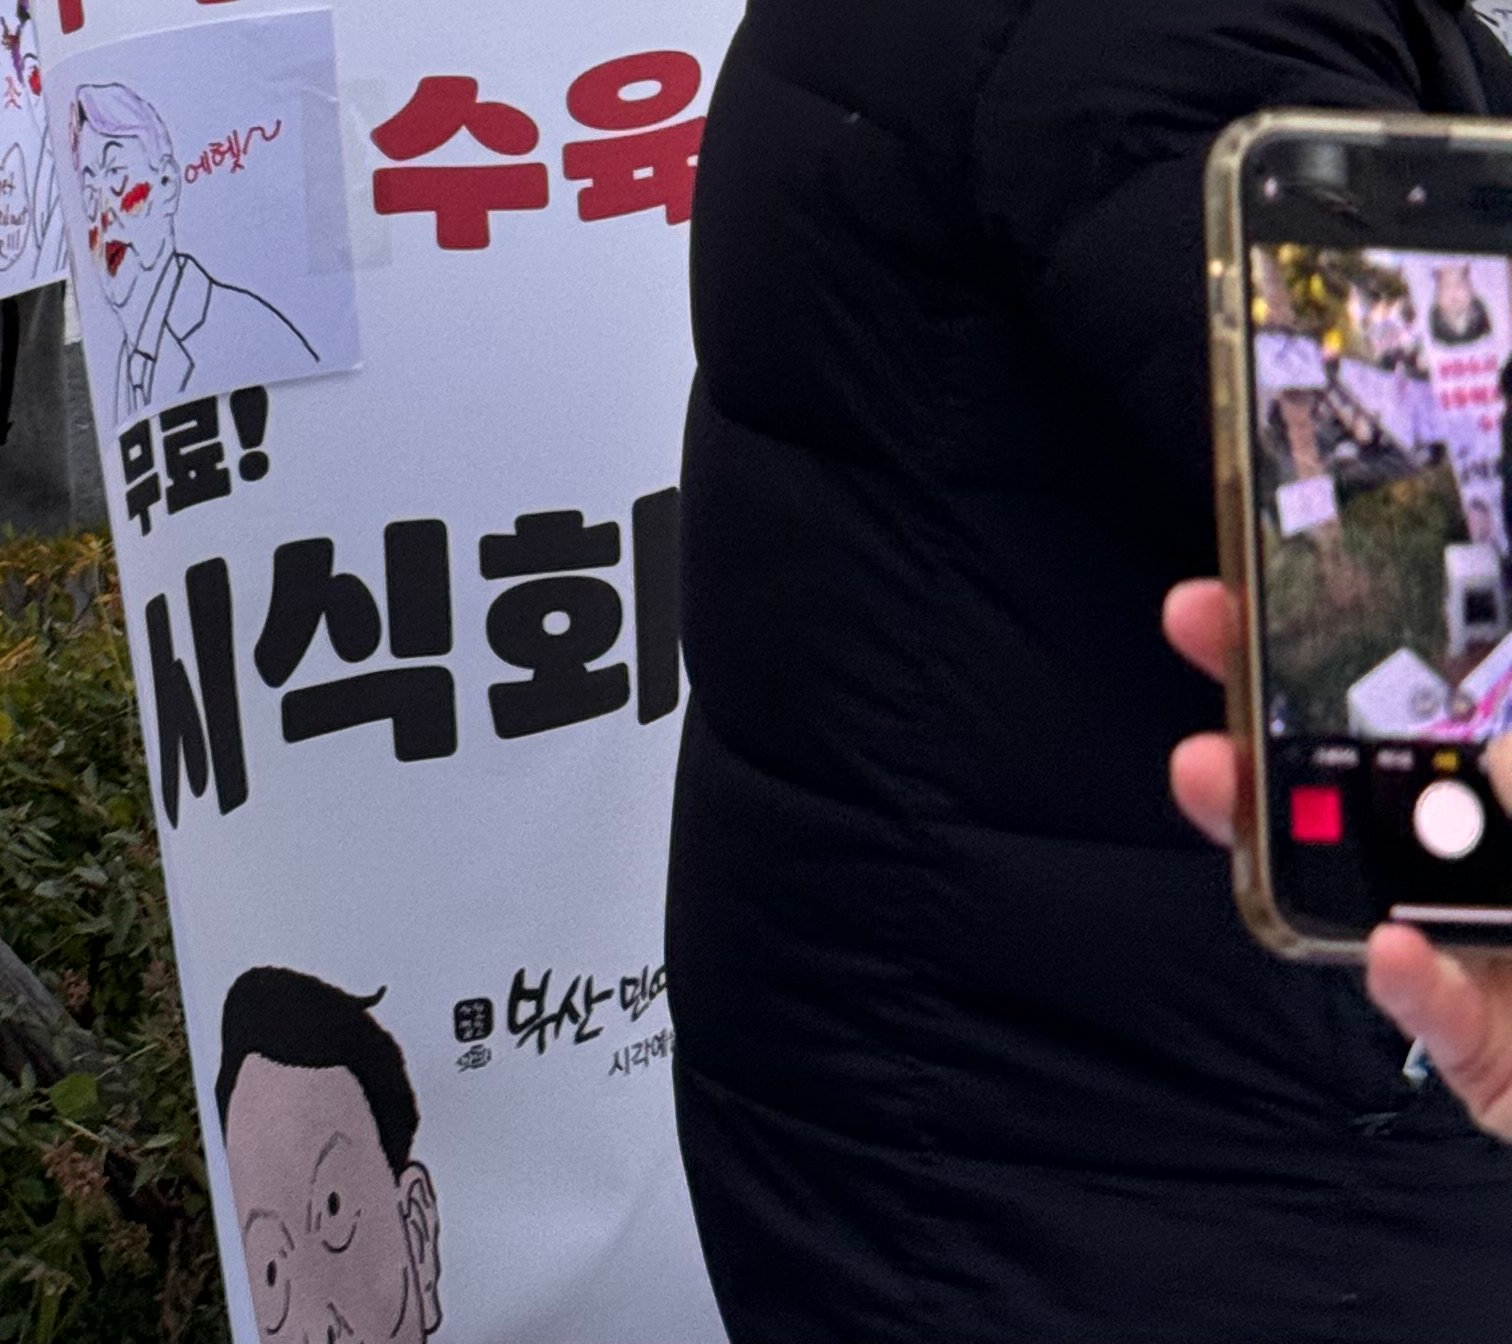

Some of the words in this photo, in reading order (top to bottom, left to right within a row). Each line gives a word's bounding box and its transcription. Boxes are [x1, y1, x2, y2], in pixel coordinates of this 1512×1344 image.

[371, 50, 708, 250] 수육
[119, 385, 270, 536] 무료!
[145, 485, 684, 830] 시식회
[507, 967, 614, 1056] 부산
